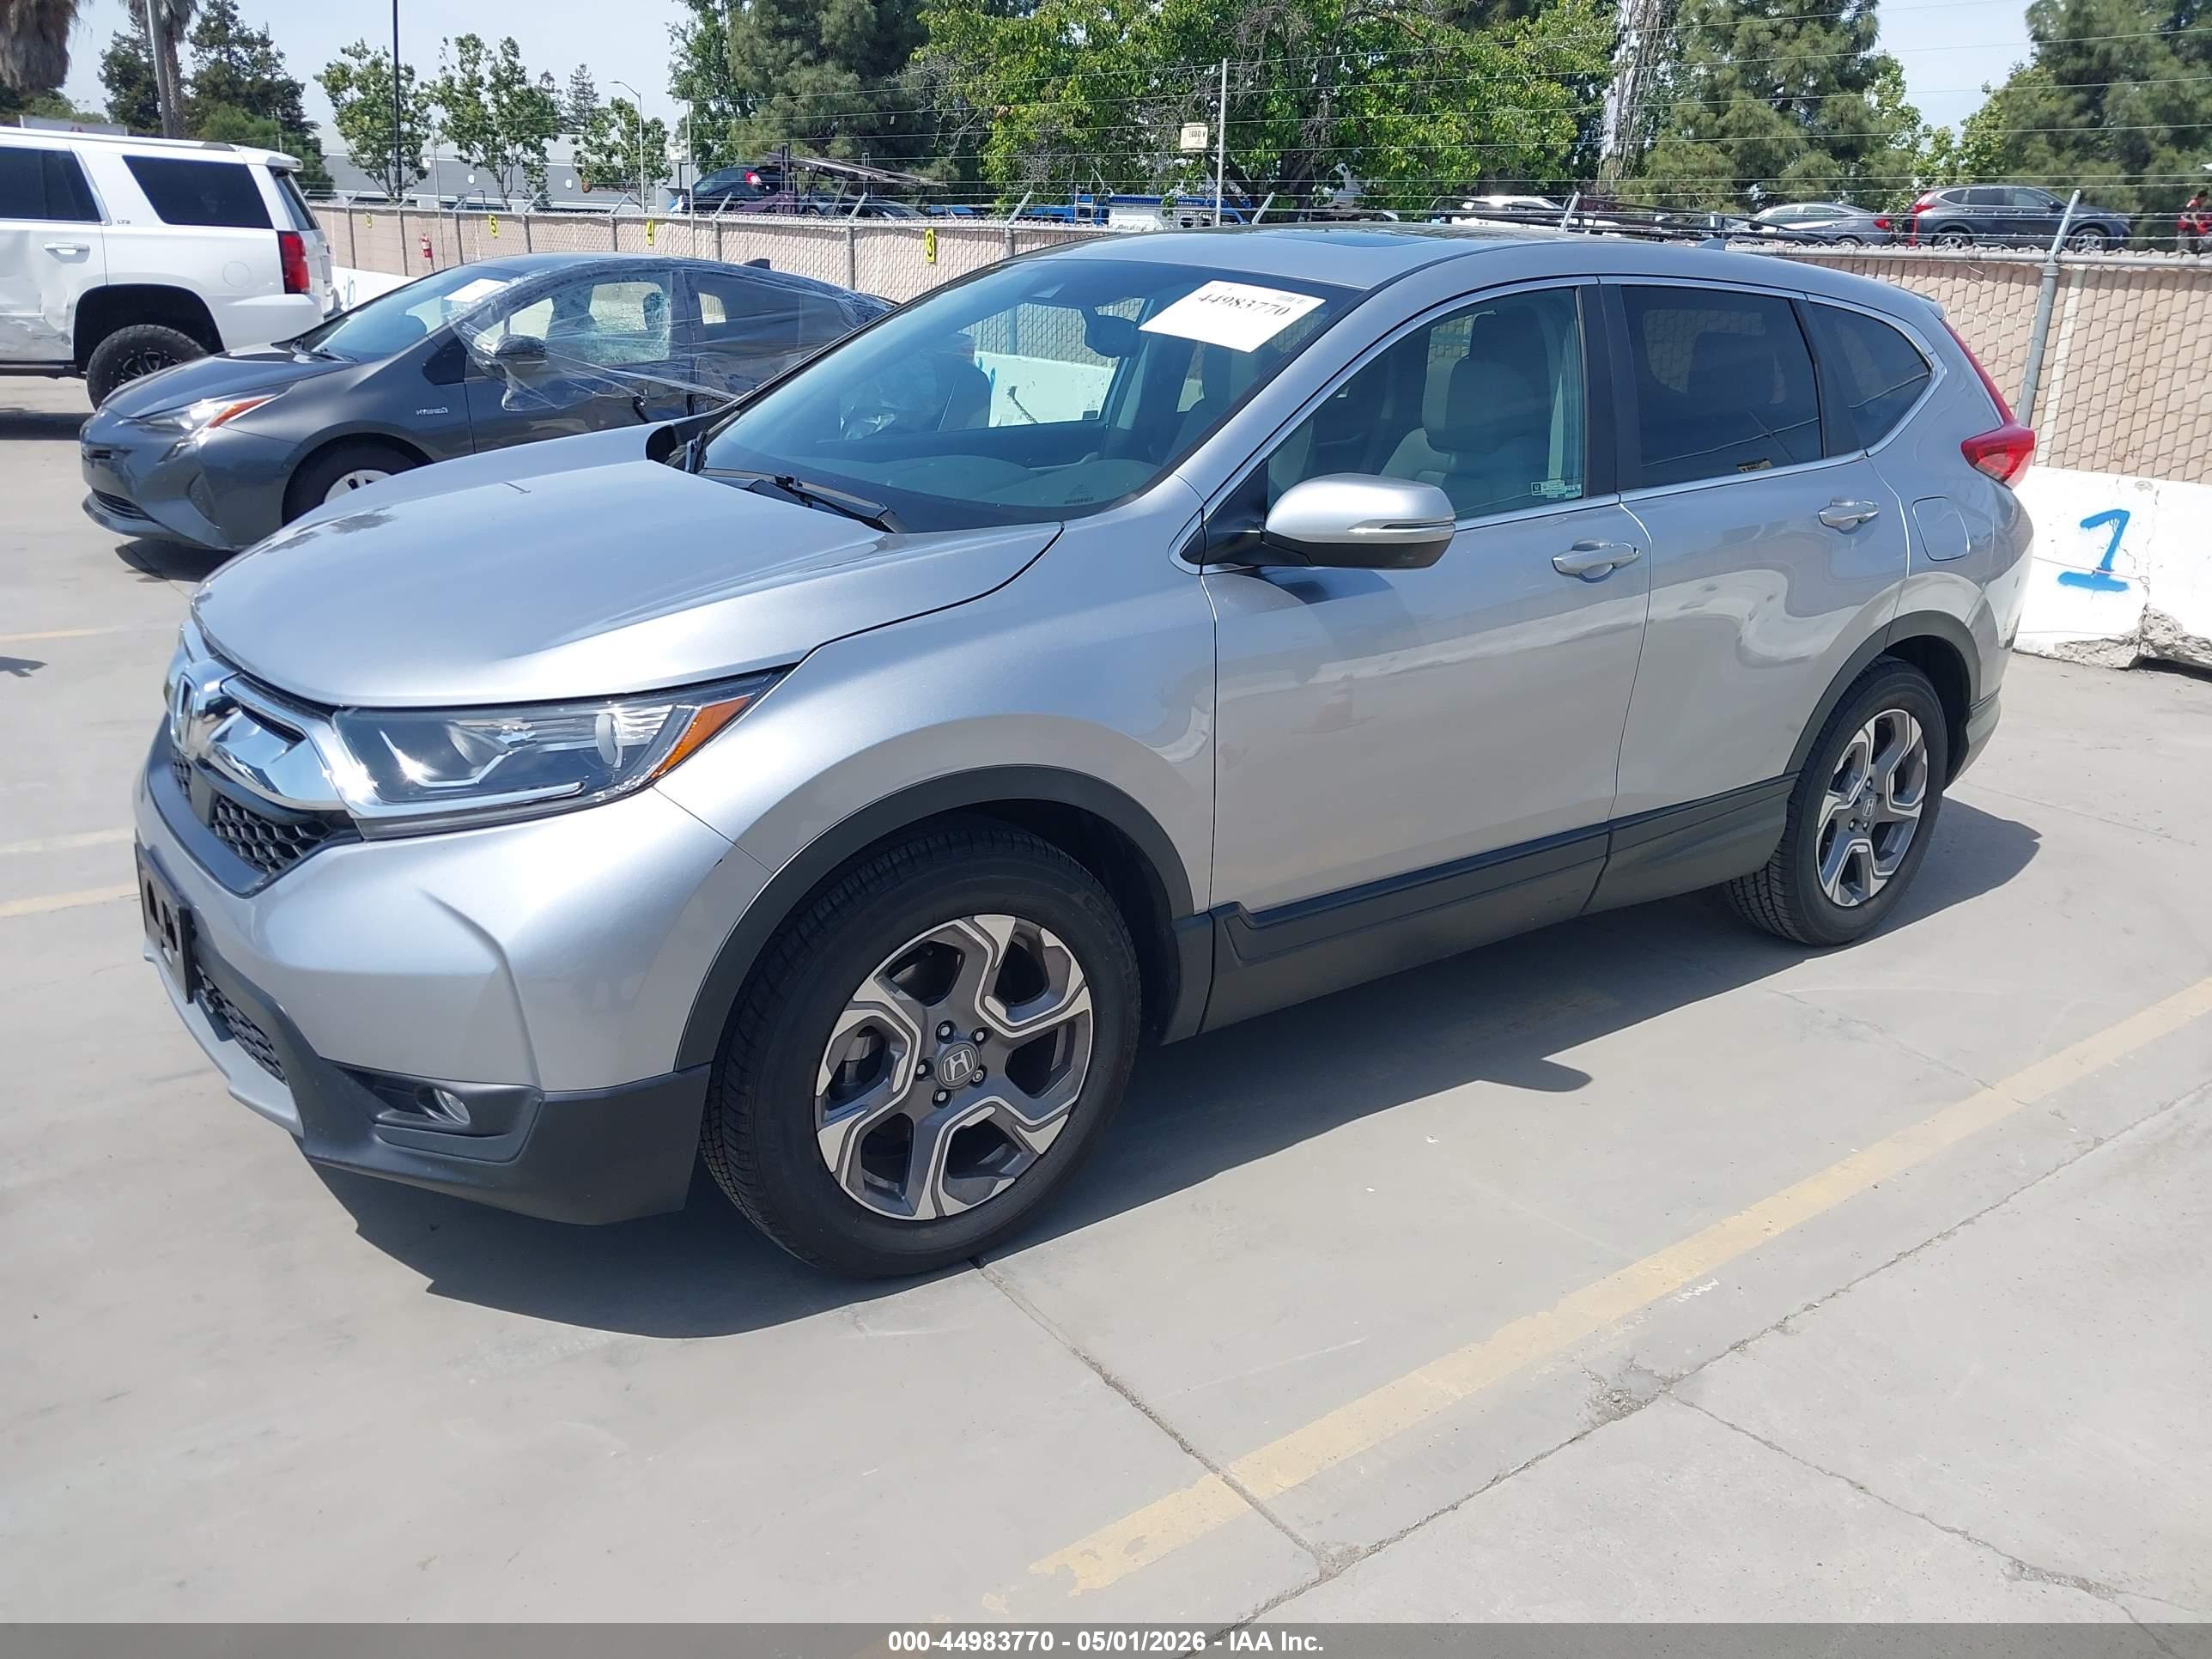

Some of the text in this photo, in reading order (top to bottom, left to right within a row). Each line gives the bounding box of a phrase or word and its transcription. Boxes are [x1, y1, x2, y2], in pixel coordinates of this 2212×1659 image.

[490, 217, 497, 234] 5
[647, 219, 653, 240] 4
[927, 233, 933, 258] 3
[1197, 293, 1291, 317] 44983770
[2057, 508, 2130, 592] 1
